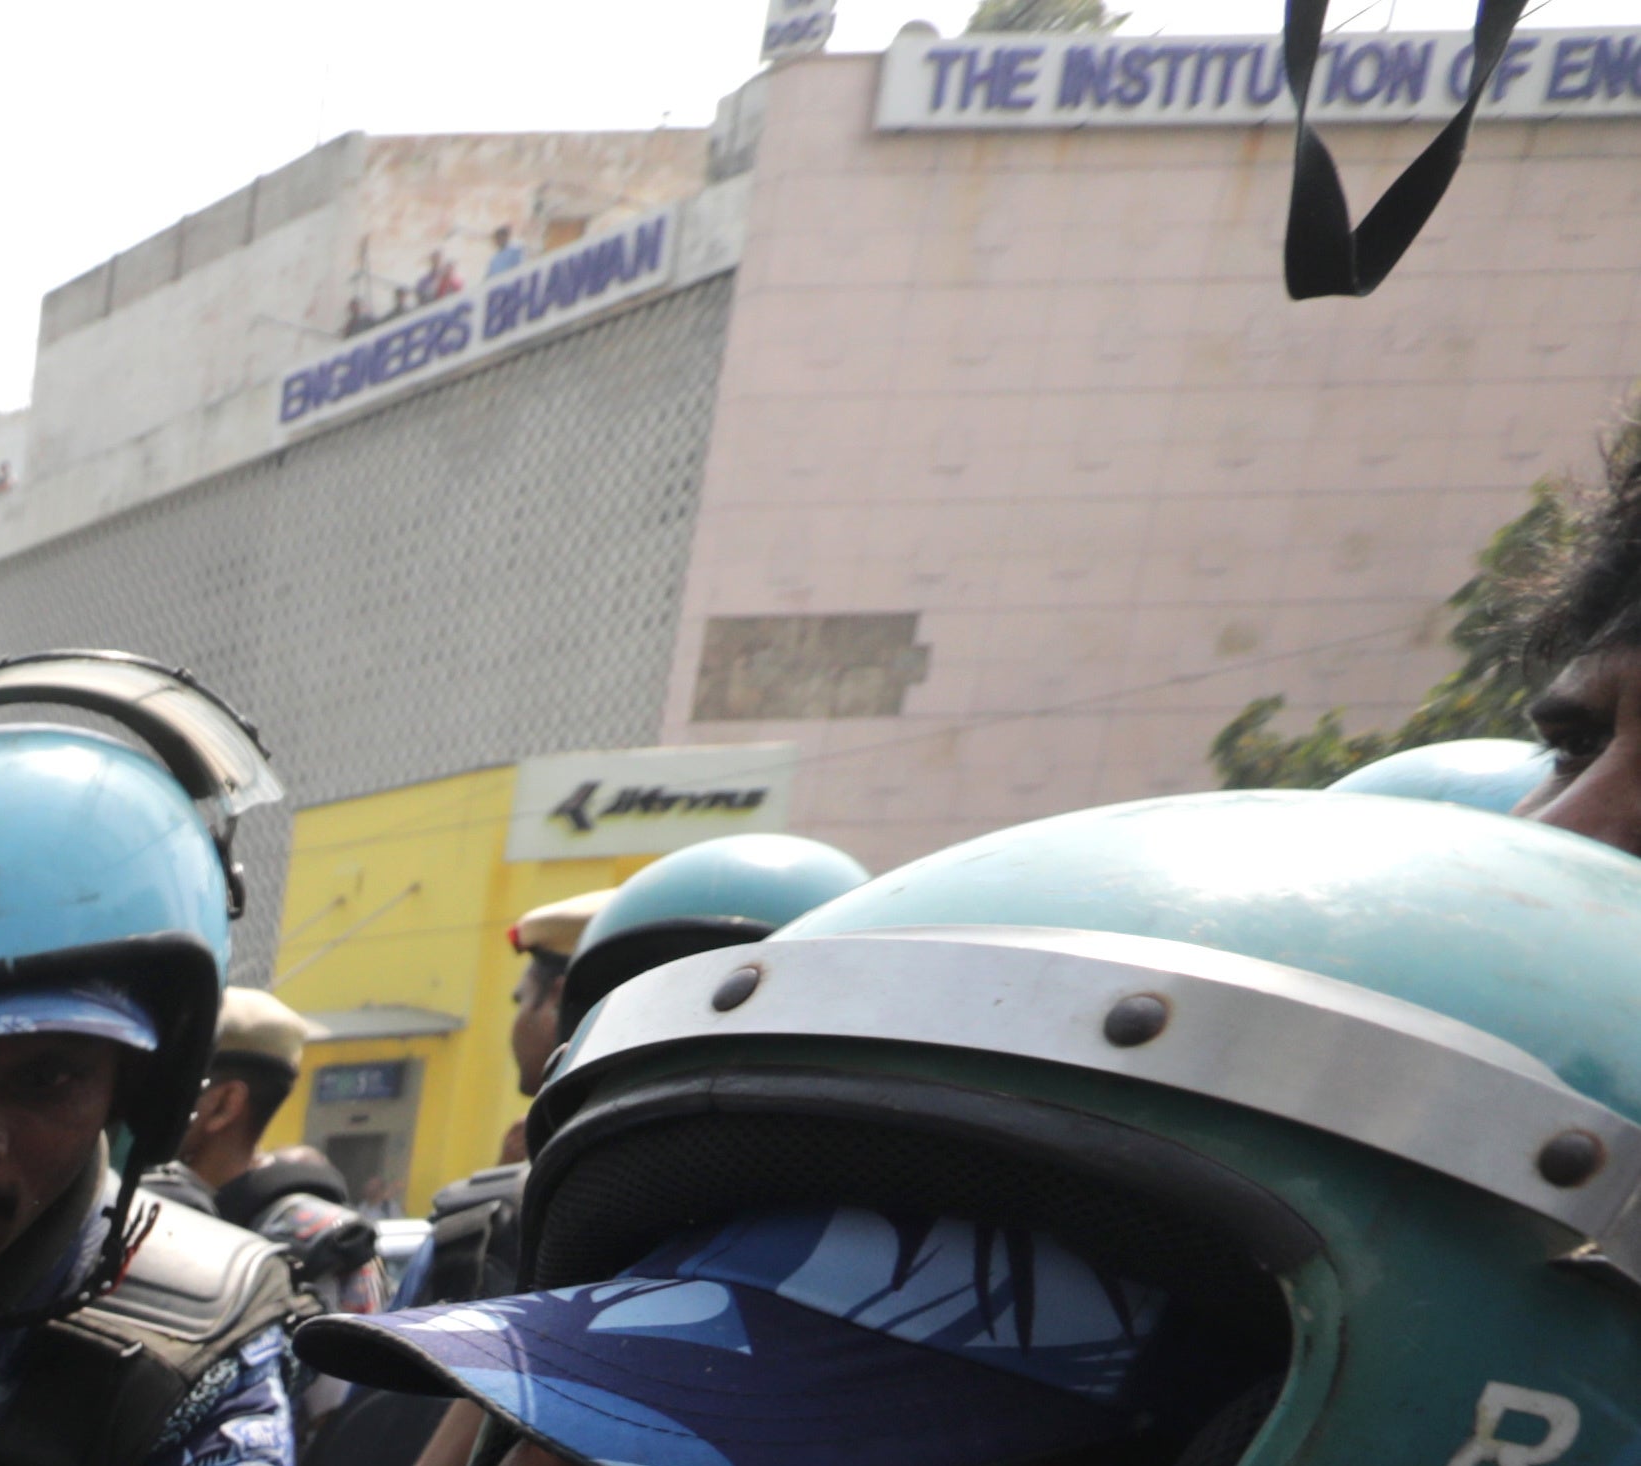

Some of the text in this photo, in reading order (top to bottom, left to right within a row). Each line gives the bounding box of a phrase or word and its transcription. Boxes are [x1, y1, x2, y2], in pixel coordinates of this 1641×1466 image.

[924, 44, 1044, 111] THE
[1053, 38, 1437, 109] INSTITUION
[279, 214, 667, 423] ENGINEERS BHAWAN
